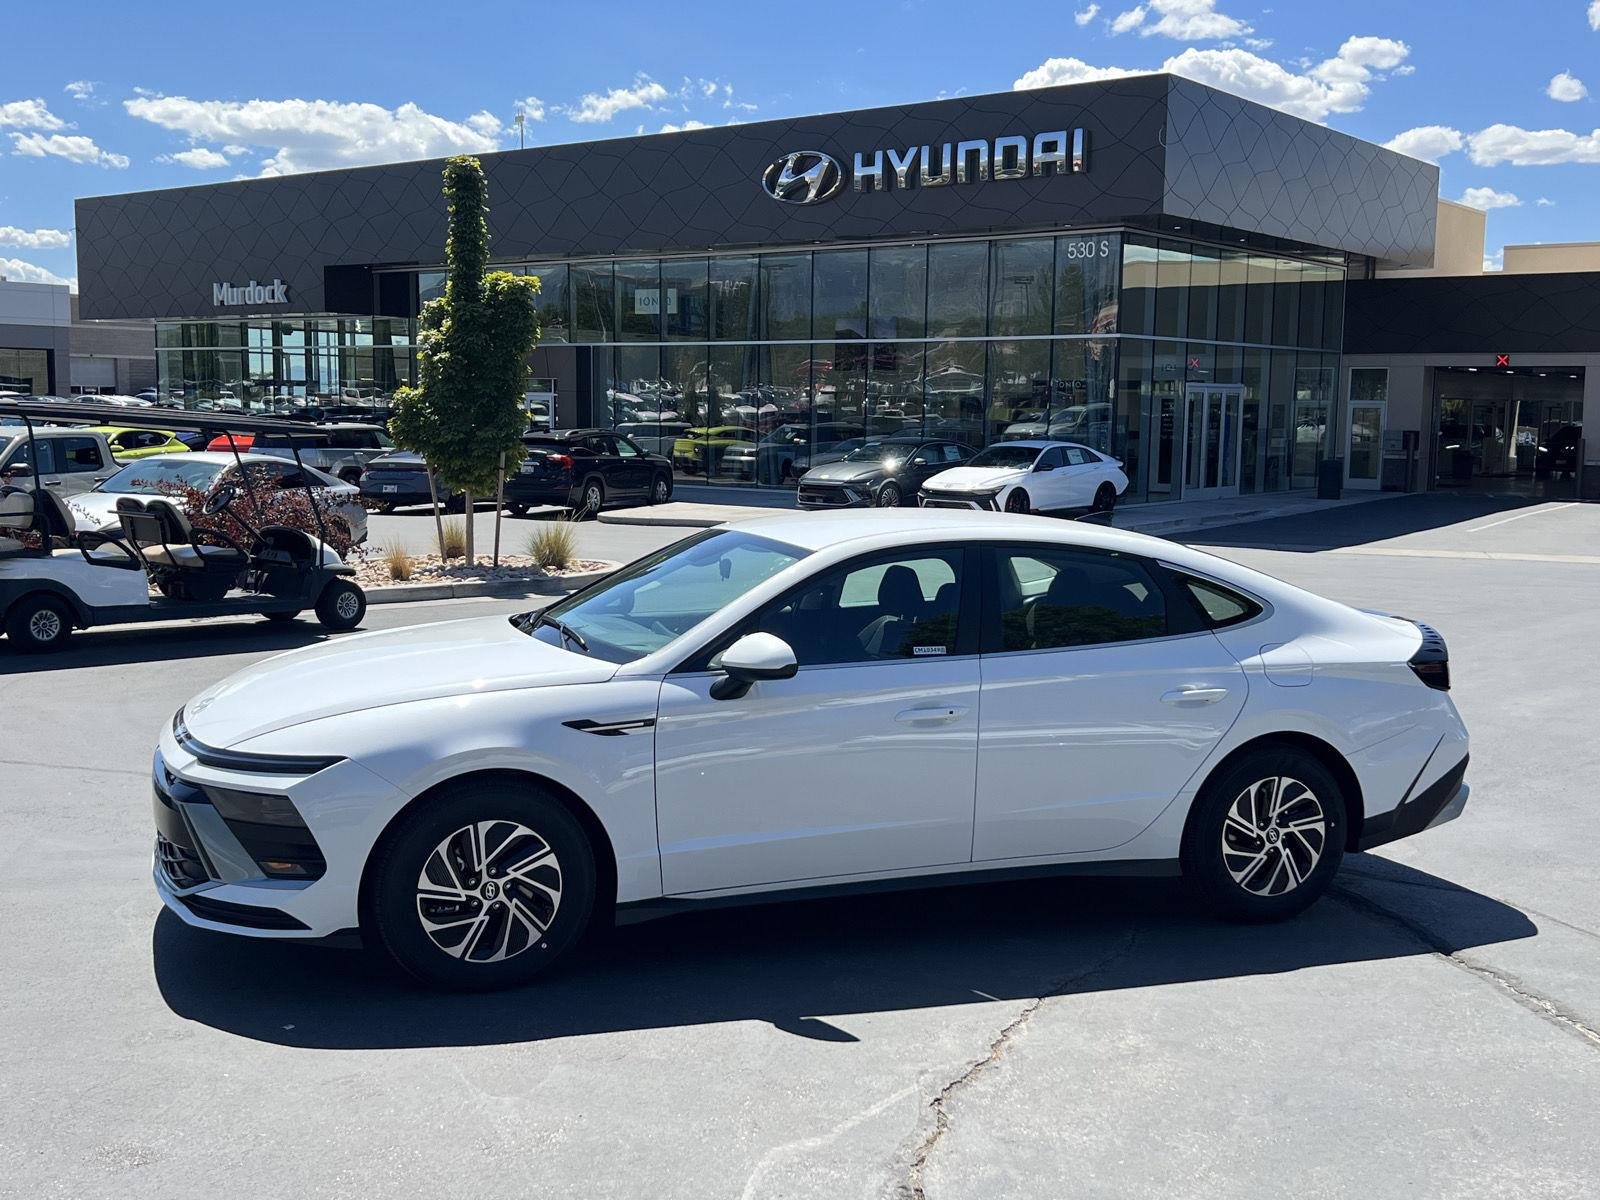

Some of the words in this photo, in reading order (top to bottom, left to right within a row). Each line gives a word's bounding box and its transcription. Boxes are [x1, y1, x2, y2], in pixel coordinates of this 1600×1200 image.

[854, 127, 1088, 193] HYUNDAI
[1067, 241, 1096, 259] 530
[1099, 240, 1109, 257] S
[212, 279, 288, 306] Murdock
